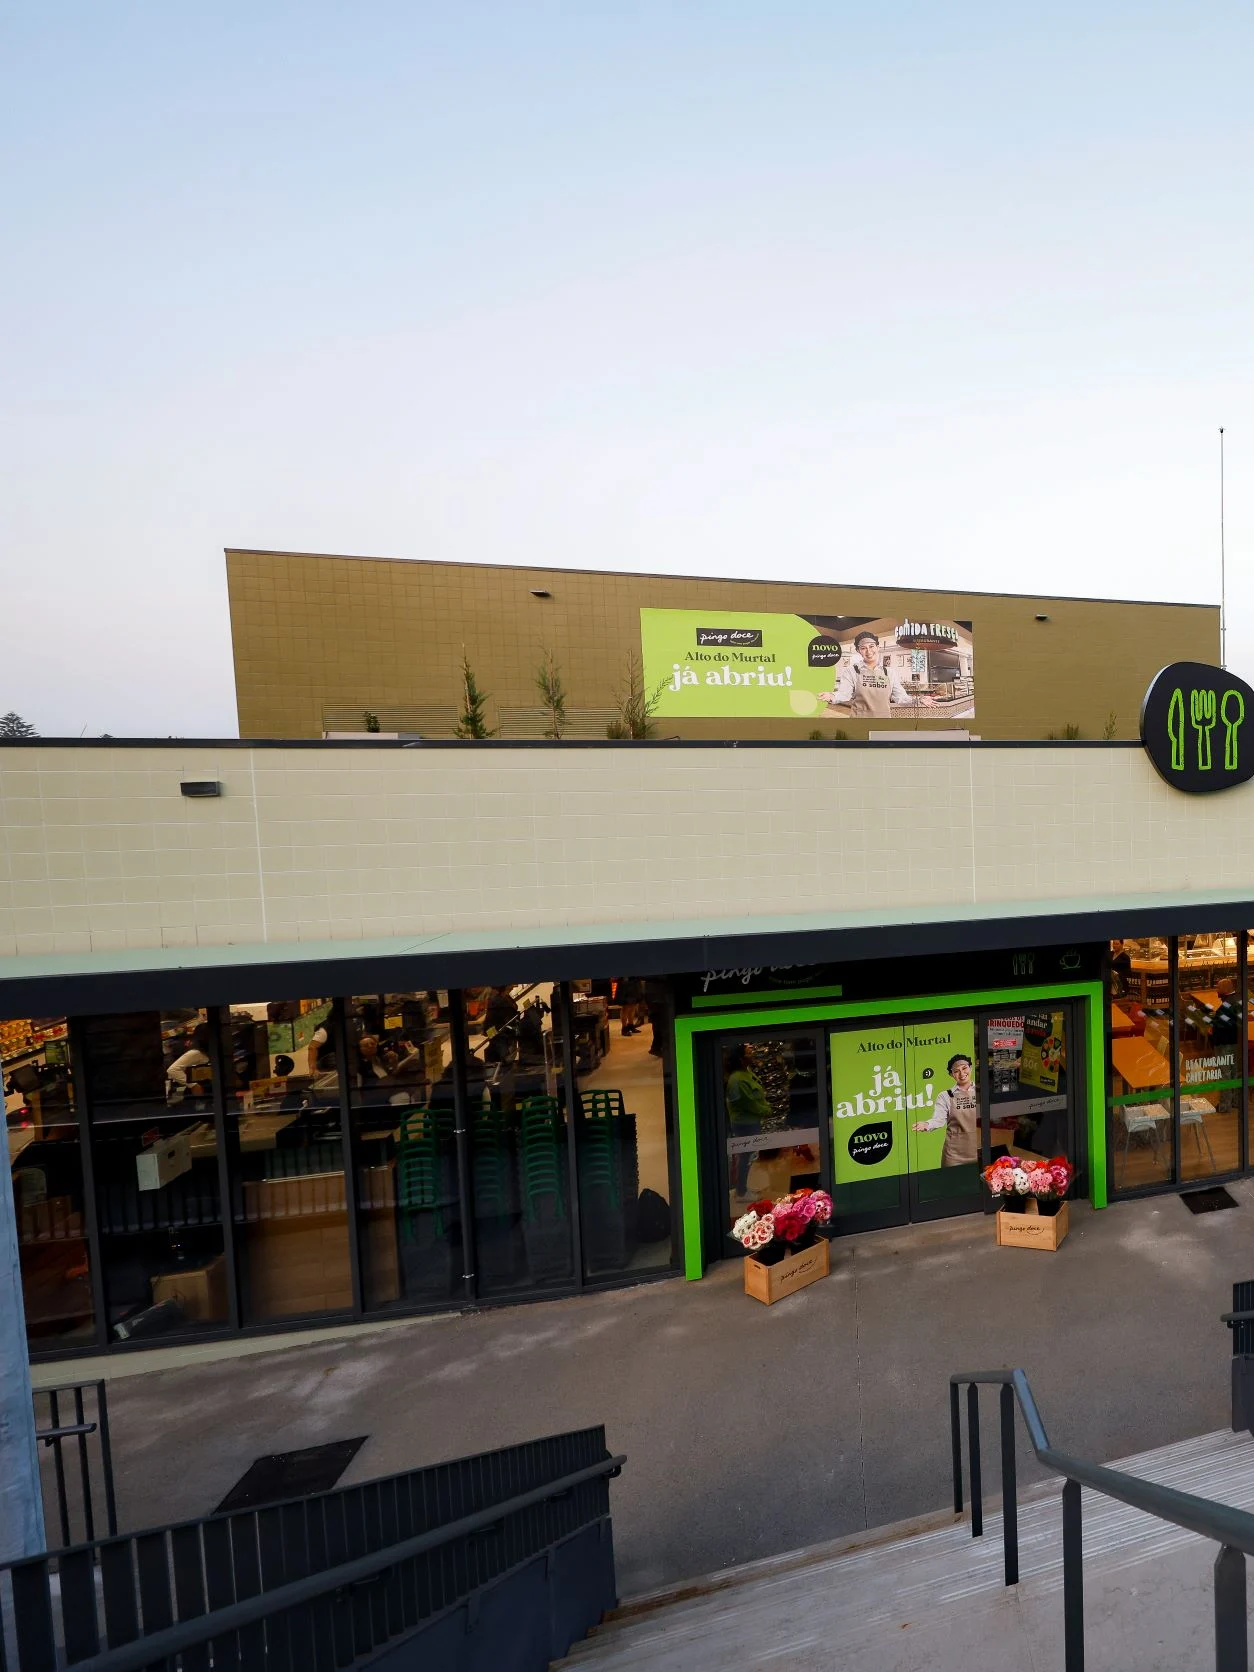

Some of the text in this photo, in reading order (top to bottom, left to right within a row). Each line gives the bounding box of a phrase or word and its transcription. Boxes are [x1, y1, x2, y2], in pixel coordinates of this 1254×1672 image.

[895, 618, 928, 637] COMIDA
[700, 632, 728, 644] pingo
[730, 631, 754, 639] doce
[812, 644, 839, 652] novo
[685, 652, 776, 663] Alto do Murtal
[669, 663, 793, 691] já abriu!
[857, 1034, 951, 1053] Alto do Murtal
[868, 1065, 903, 1097] já
[836, 1083, 934, 1119] abriu!
[853, 1131, 888, 1144] novo
[852, 1142, 889, 1156] pingo doce
